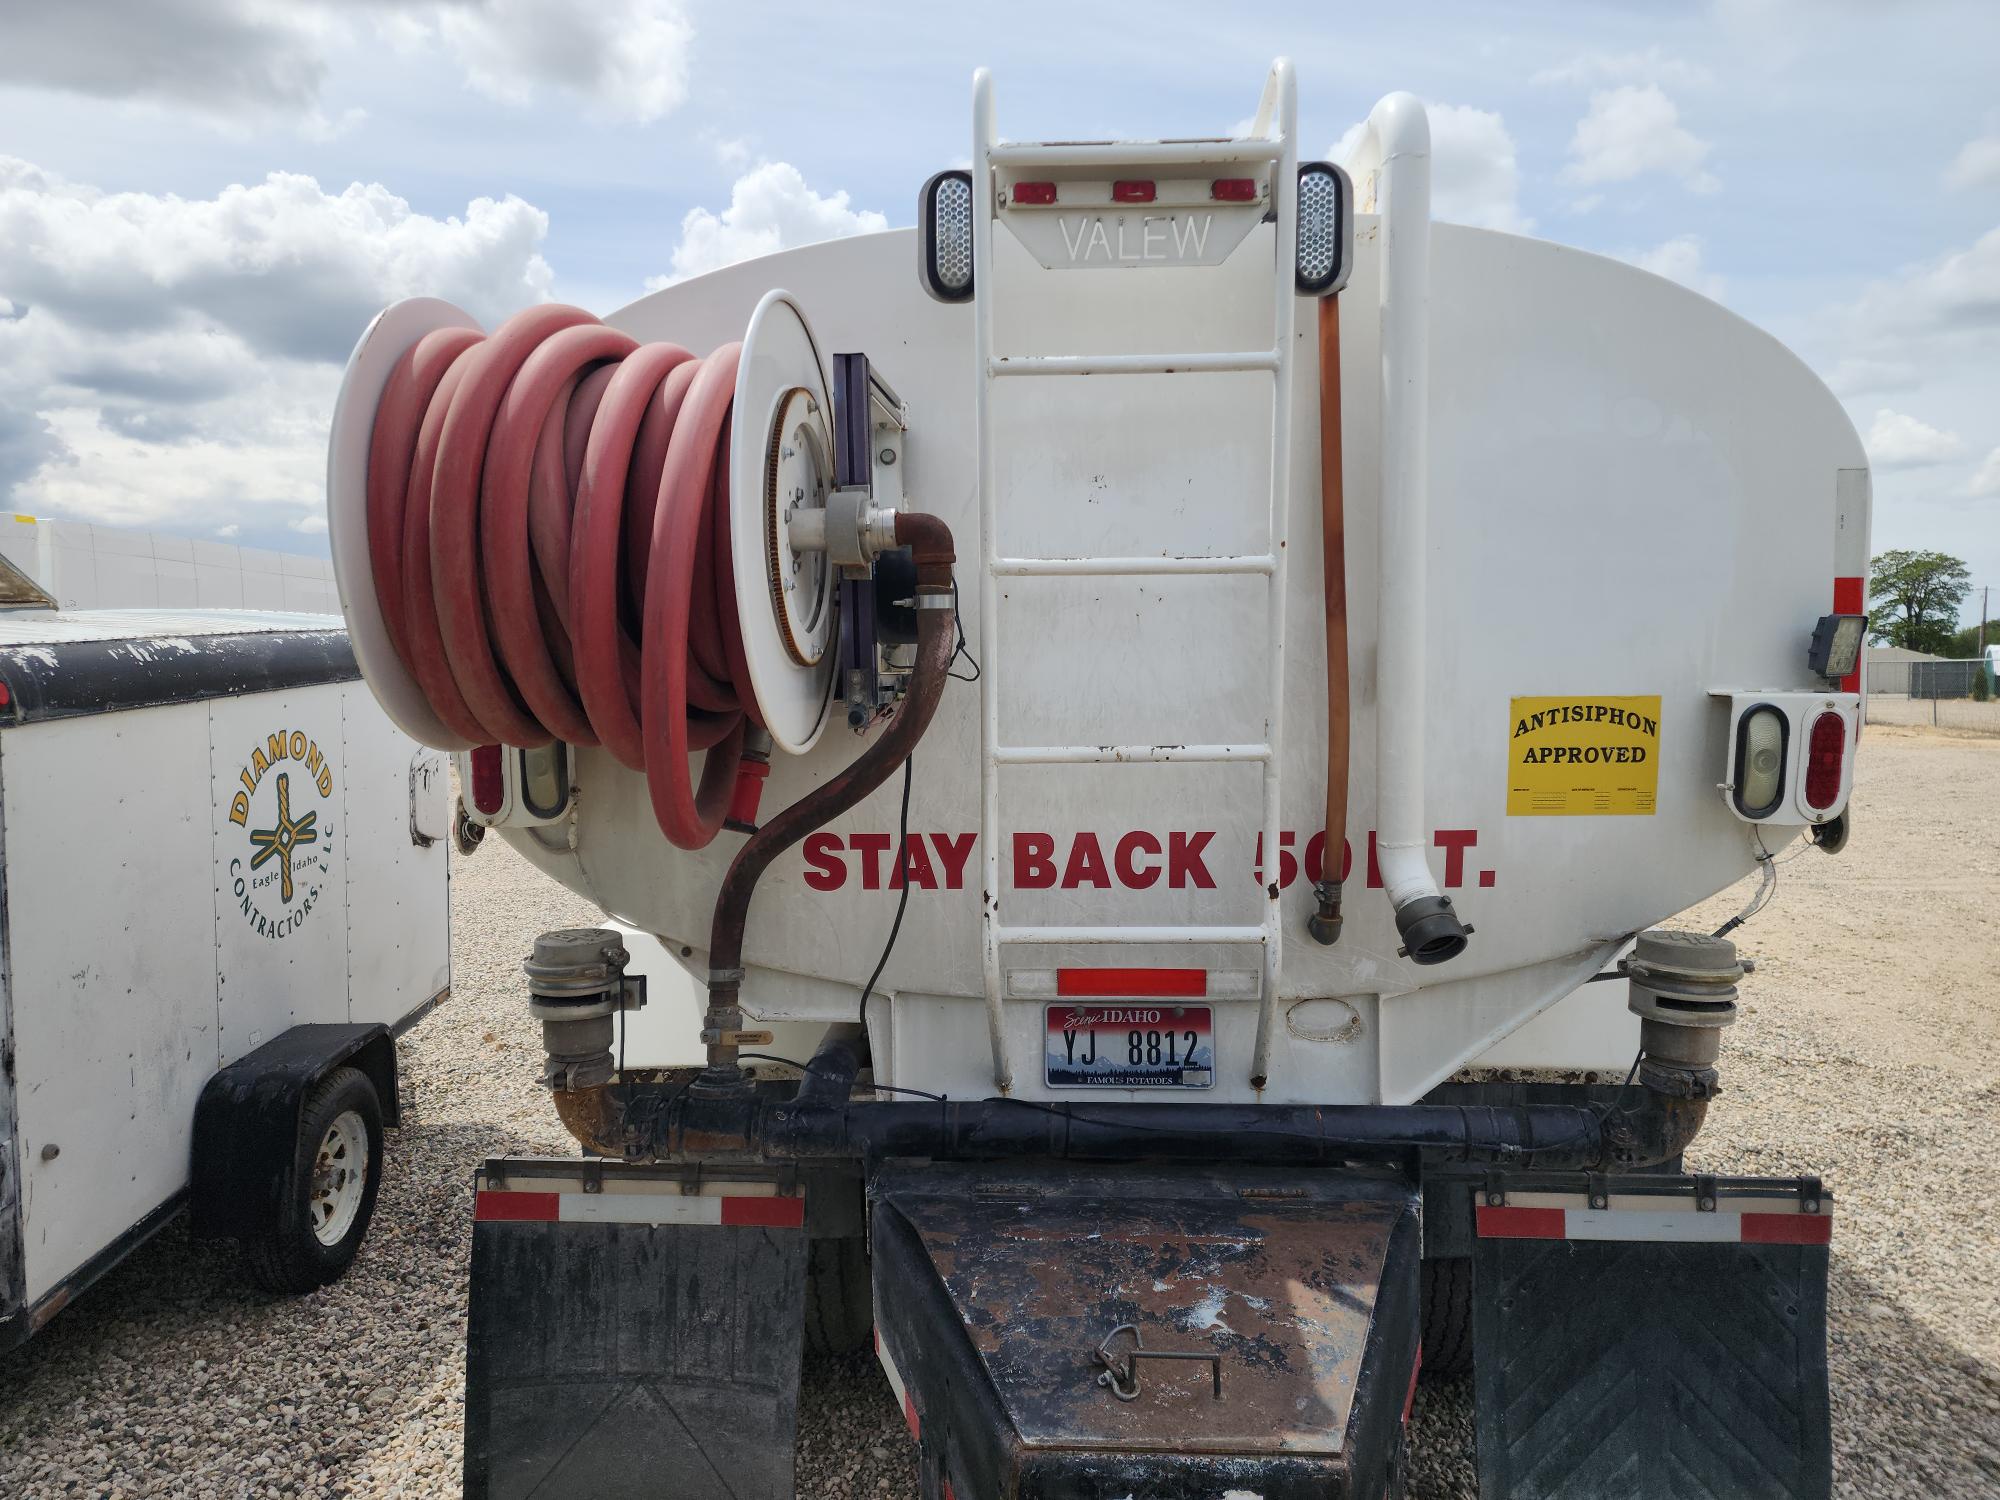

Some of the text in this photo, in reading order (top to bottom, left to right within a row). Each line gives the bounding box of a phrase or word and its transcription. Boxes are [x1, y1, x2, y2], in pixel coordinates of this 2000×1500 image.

[1059, 215, 1212, 261] VALEW
[1513, 705, 1657, 738] ANTISIPHON
[1523, 747, 1646, 764] APPROVED
[229, 729, 333, 828] DIAMOND
[319, 822, 334, 874] LLC
[802, 832, 977, 891] STAY
[1013, 831, 1216, 889] BACK
[252, 855, 318, 888] Eagle Idaho
[1064, 1010, 1160, 1028] Scenic IDAHO
[1063, 1030, 1198, 1066] YJ 8812
[1087, 1076, 1173, 1085] FAMOUS POTATOES
